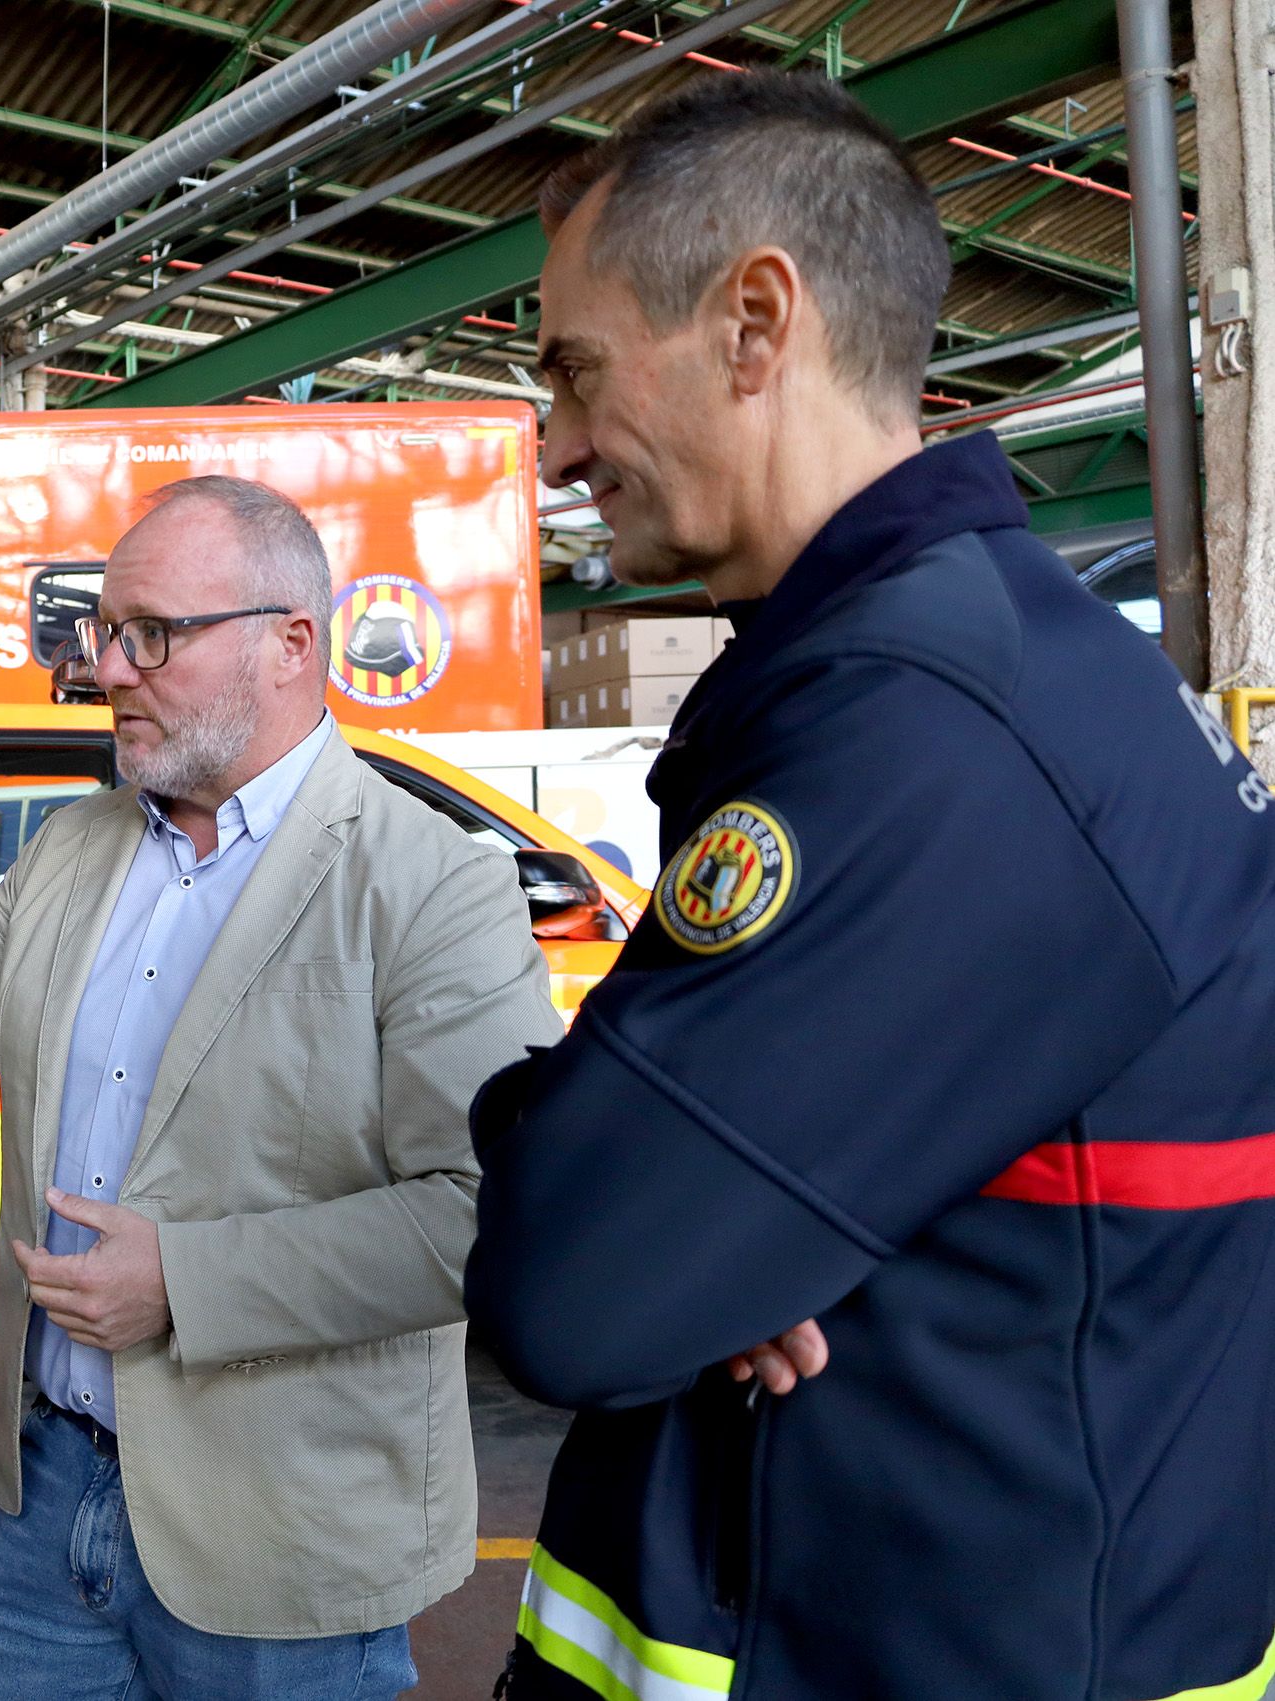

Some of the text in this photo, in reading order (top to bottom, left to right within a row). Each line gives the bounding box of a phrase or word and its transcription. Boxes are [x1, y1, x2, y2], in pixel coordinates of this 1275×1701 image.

[356, 575, 413, 589] BOMBERS
[346, 686, 408, 707] PROVINCIAL
[408, 683, 425, 701] DE
[698, 811, 781, 868] BOMBERS
